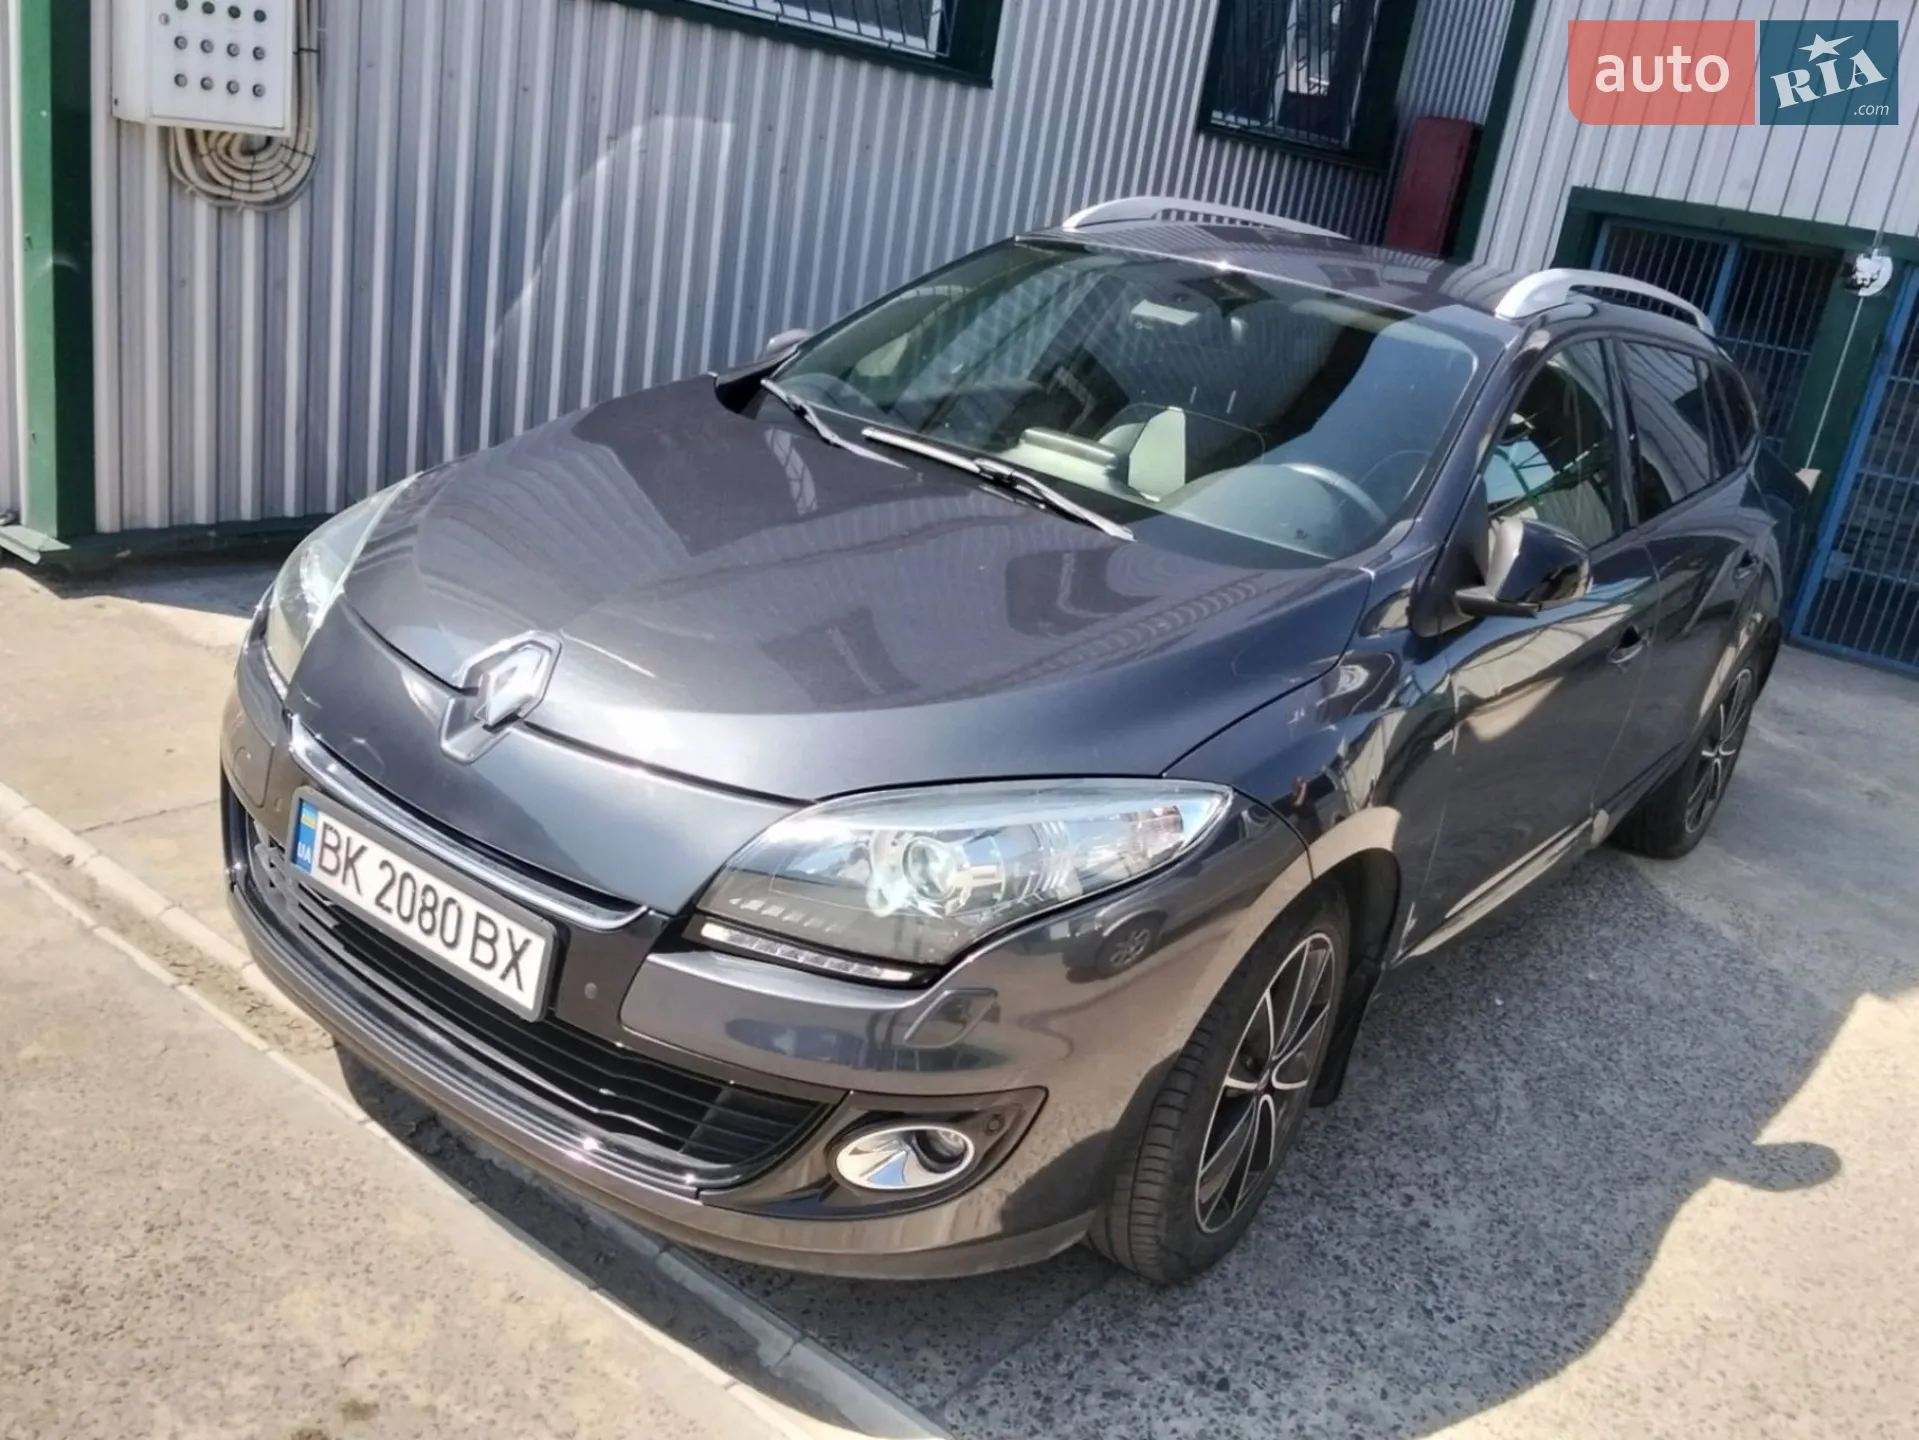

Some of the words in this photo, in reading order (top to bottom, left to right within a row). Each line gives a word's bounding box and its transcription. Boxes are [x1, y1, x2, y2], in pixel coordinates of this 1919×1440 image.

[297, 841, 312, 864] UA
[318, 821, 368, 896] BK
[375, 860, 463, 950] 2080
[469, 911, 532, 992] BX
